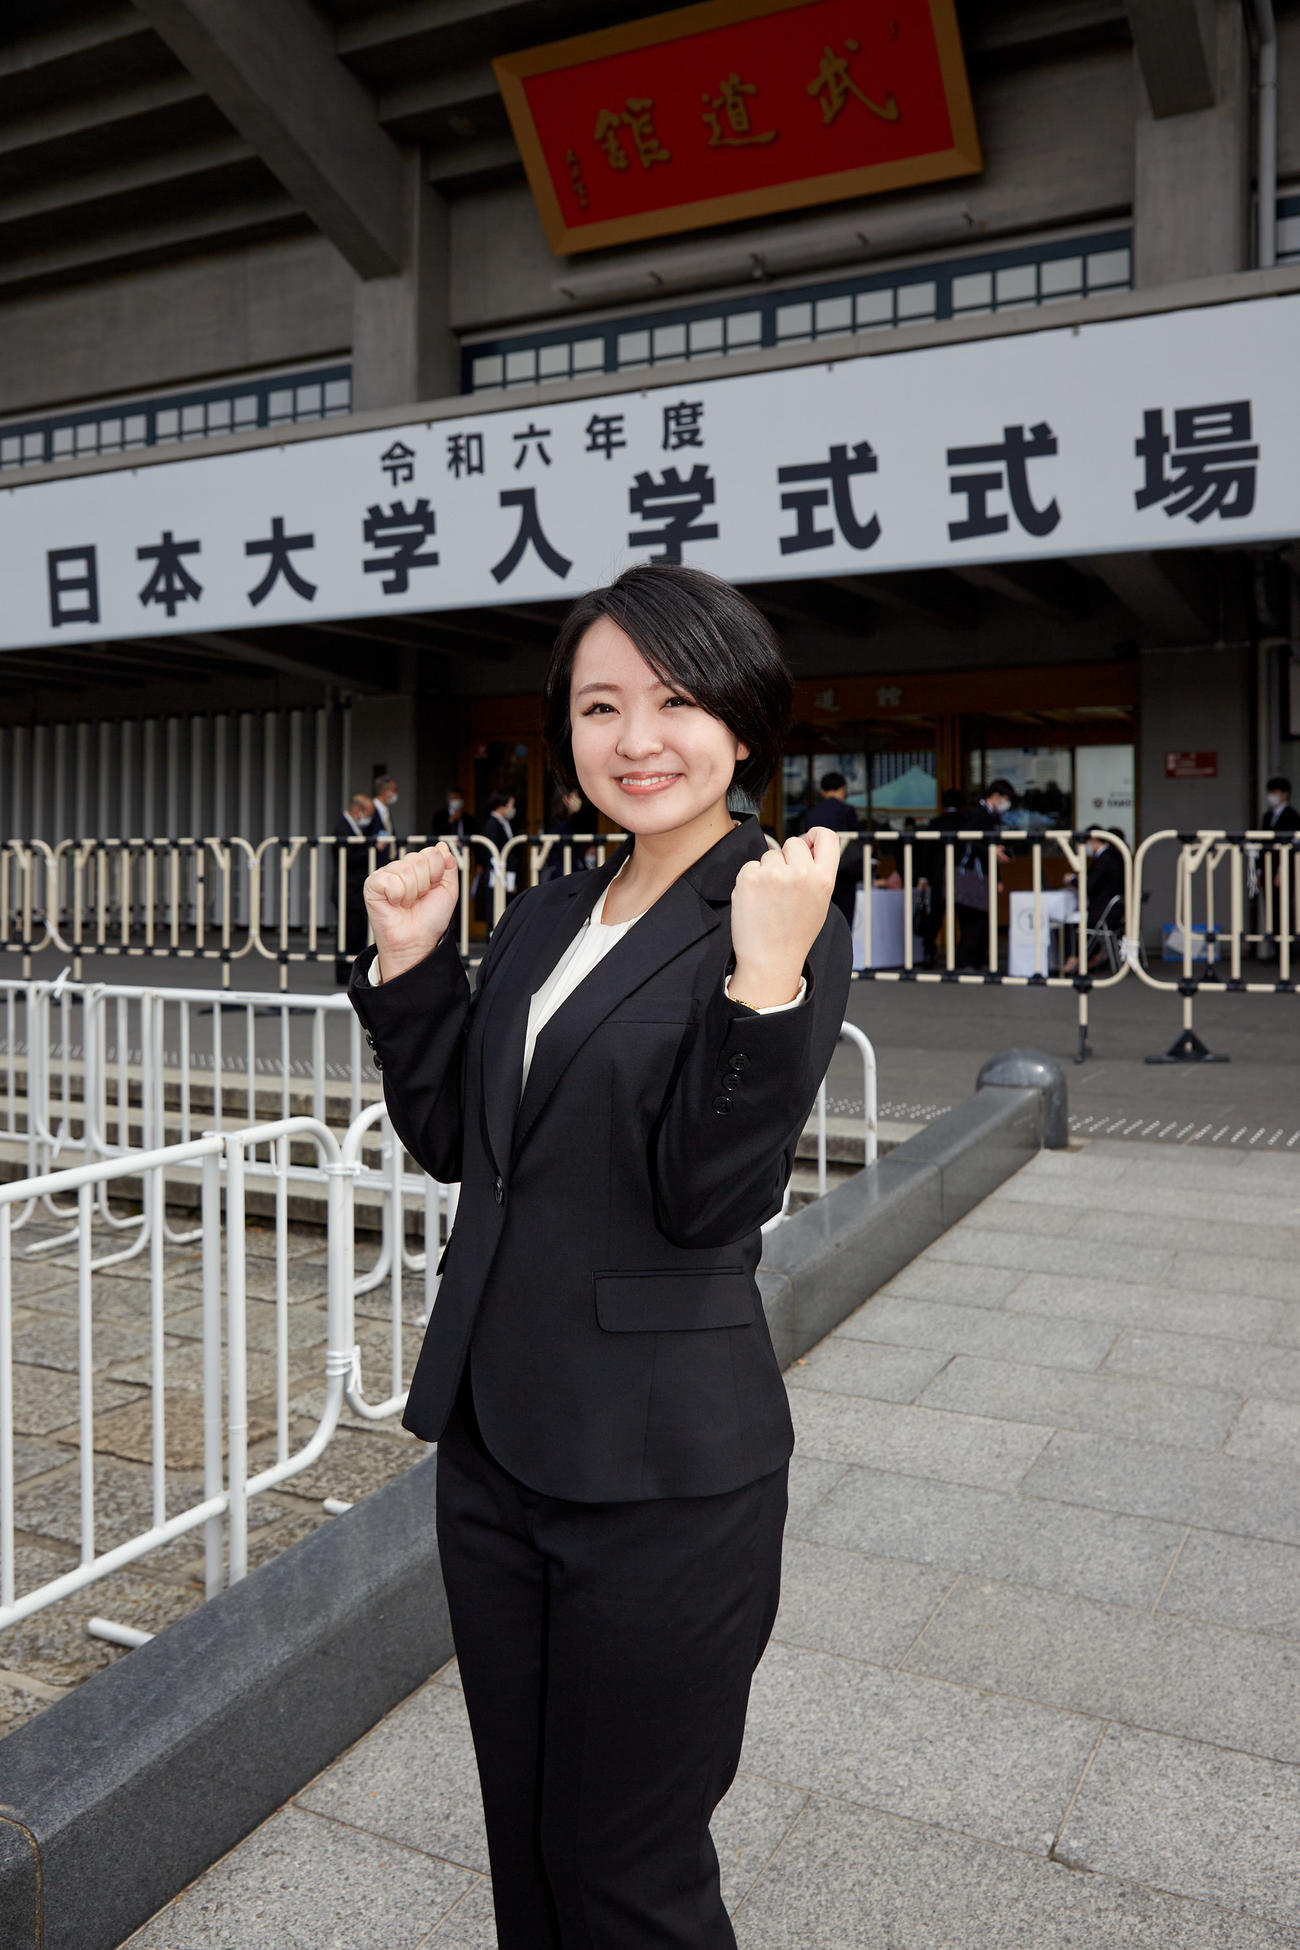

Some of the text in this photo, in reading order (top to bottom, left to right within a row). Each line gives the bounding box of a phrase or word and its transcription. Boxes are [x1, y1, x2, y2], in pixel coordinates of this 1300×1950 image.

[47, 399, 1261, 627] 日本大学入学式式場
[380, 401, 706, 487] 令和六年度
